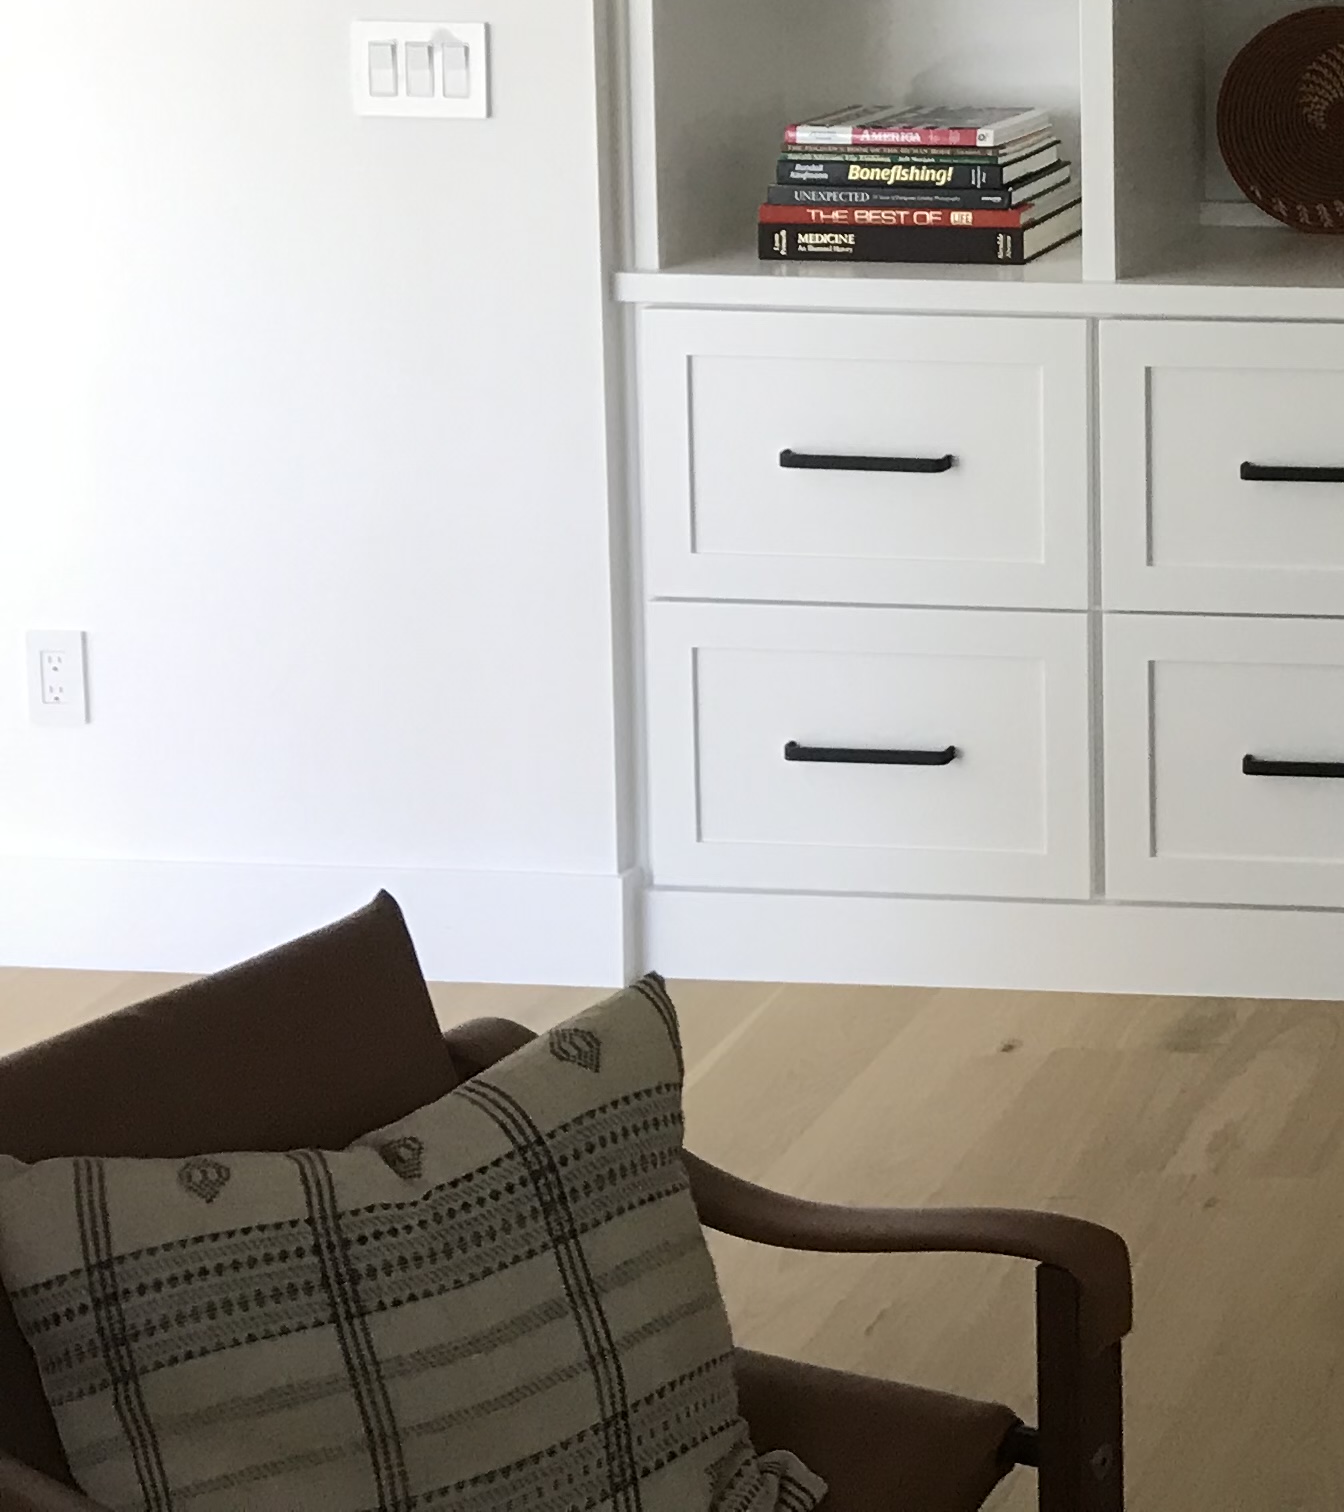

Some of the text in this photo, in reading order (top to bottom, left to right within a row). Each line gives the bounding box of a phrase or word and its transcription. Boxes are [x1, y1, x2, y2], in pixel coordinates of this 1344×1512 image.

[860, 130, 921, 142] AMERICA
[848, 164, 954, 186] Bonefishing!
[794, 190, 870, 202] UNEXPECTED
[806, 208, 972, 226] THE BEST OF LIFE
[797, 233, 856, 244] MEDICINE
